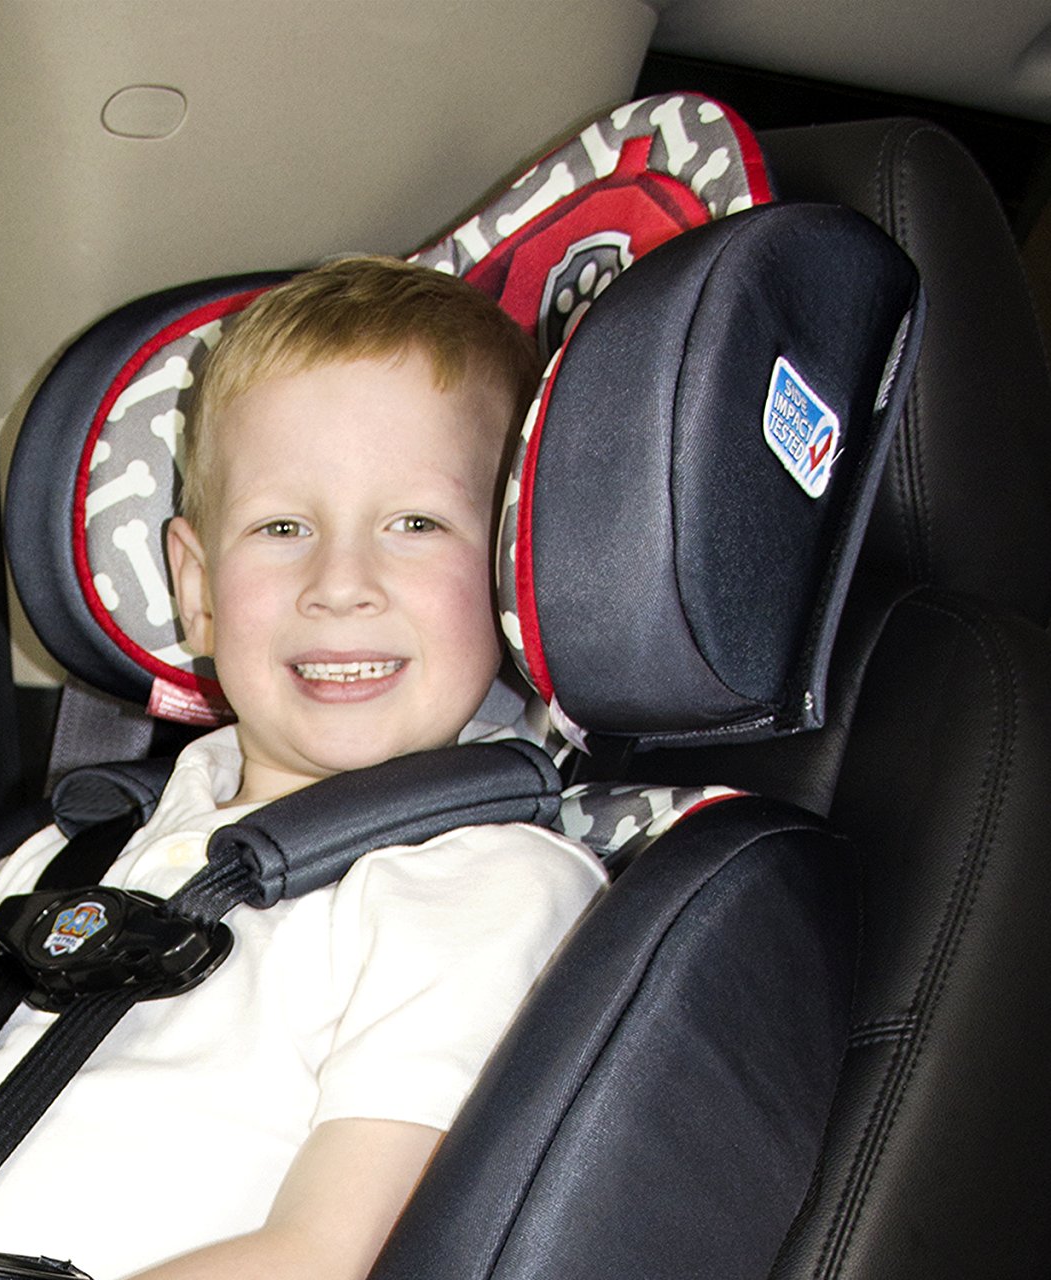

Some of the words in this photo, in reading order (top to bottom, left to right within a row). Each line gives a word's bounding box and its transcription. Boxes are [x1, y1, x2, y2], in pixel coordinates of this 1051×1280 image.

[774, 392, 813, 442] IMPACT
[784, 380, 807, 415] SIDE
[769, 411, 805, 461] TESTED
[52, 908, 108, 939] PAW
